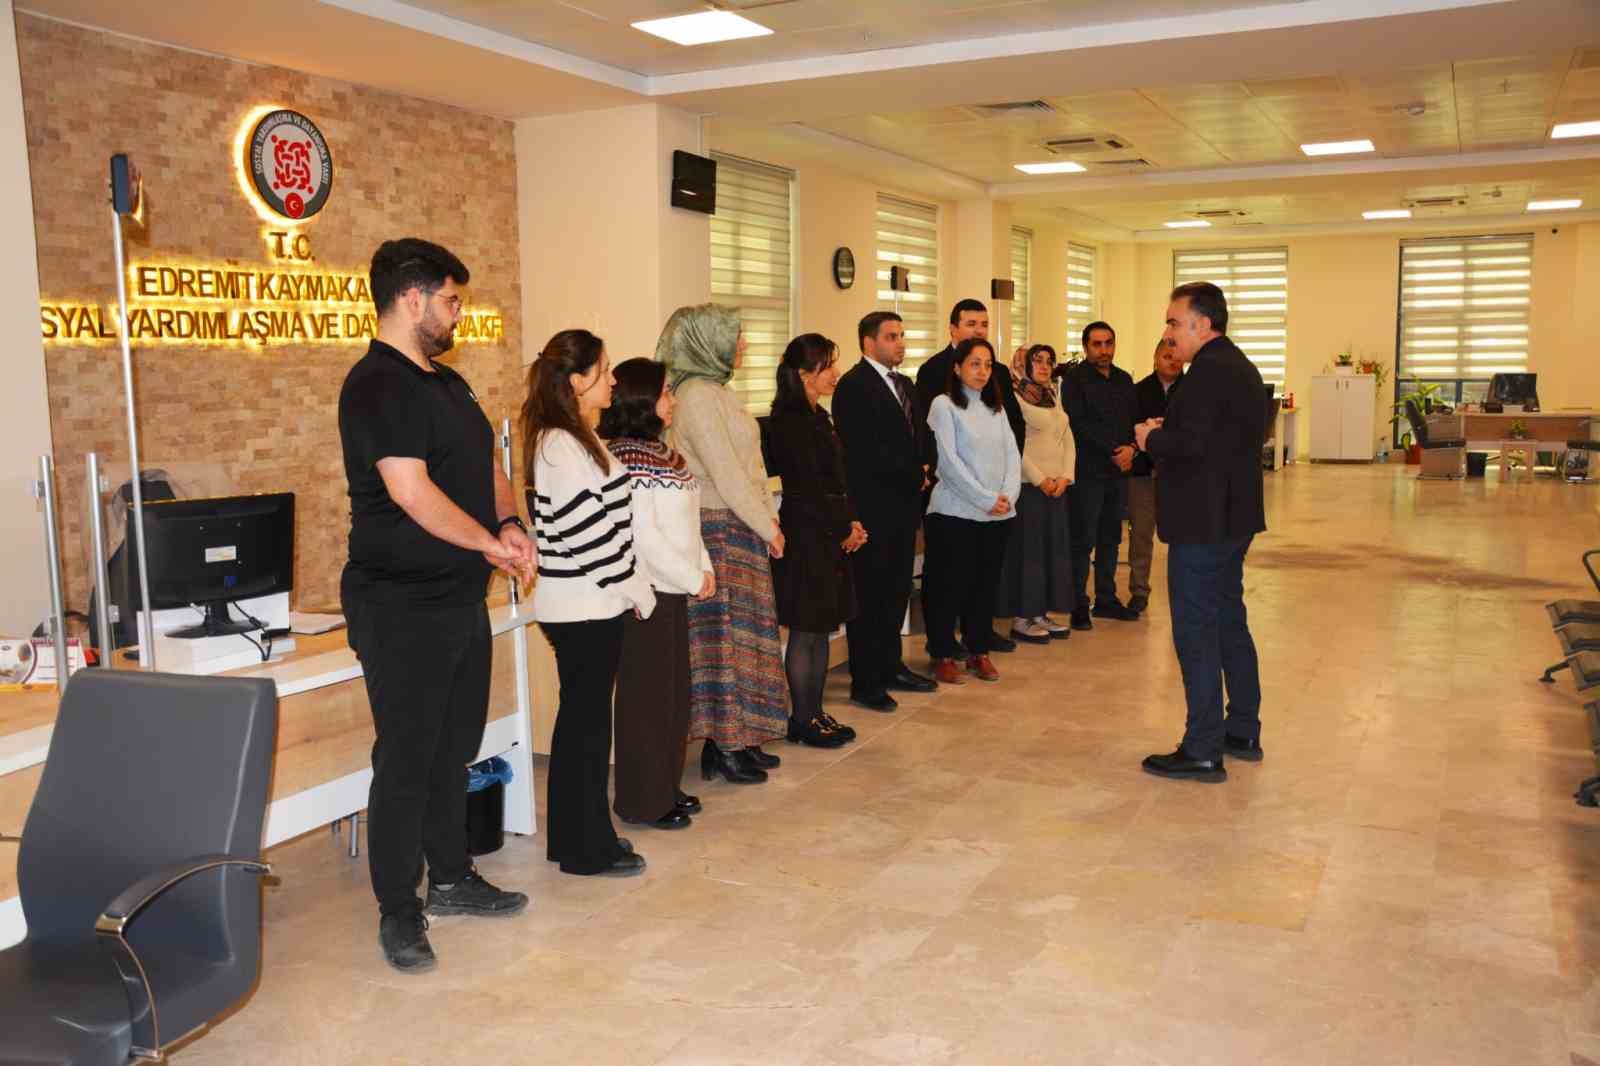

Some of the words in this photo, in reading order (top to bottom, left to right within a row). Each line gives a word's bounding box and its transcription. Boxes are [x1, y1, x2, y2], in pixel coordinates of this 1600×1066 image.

[269, 232, 315, 262] T.C.
[256, 272, 371, 302] KAYMAKA
[41, 306, 116, 338] SYAL
[119, 308, 307, 345] YARDIMLAŞMA
[308, 312, 340, 338] VE
[343, 313, 379, 338] DAY
